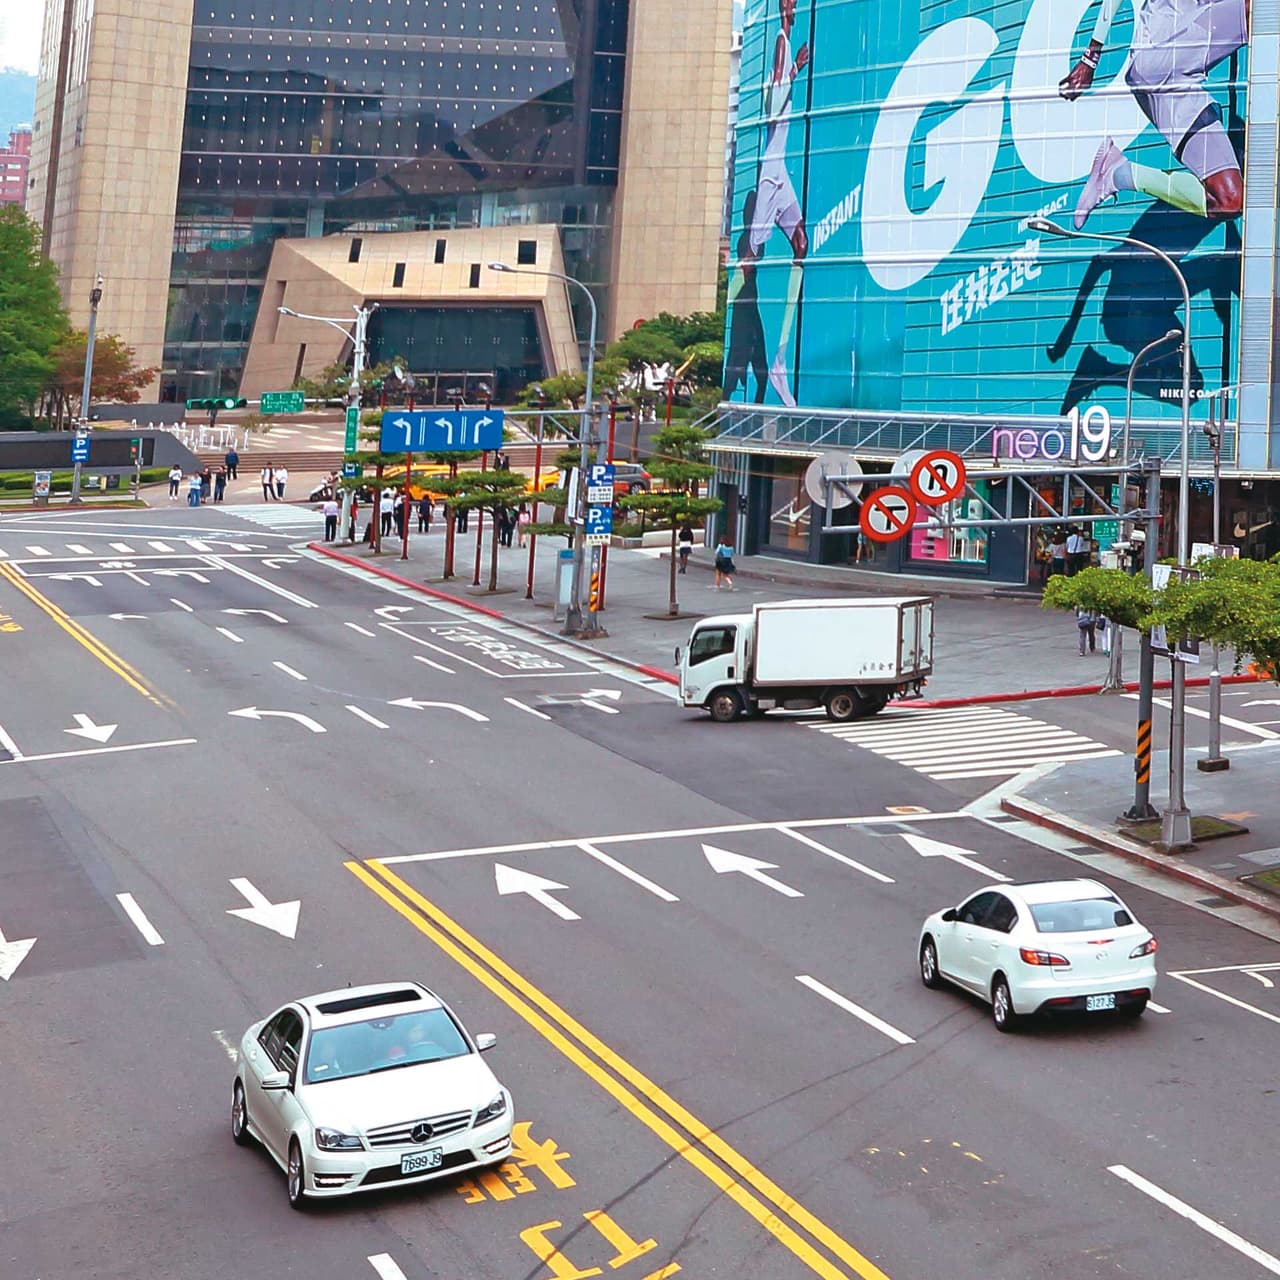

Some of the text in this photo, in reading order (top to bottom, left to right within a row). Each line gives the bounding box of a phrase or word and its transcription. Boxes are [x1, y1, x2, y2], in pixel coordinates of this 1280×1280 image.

[813, 184, 861, 253] INSTANT
[592, 465, 606, 481] P
[588, 508, 602, 524] P
